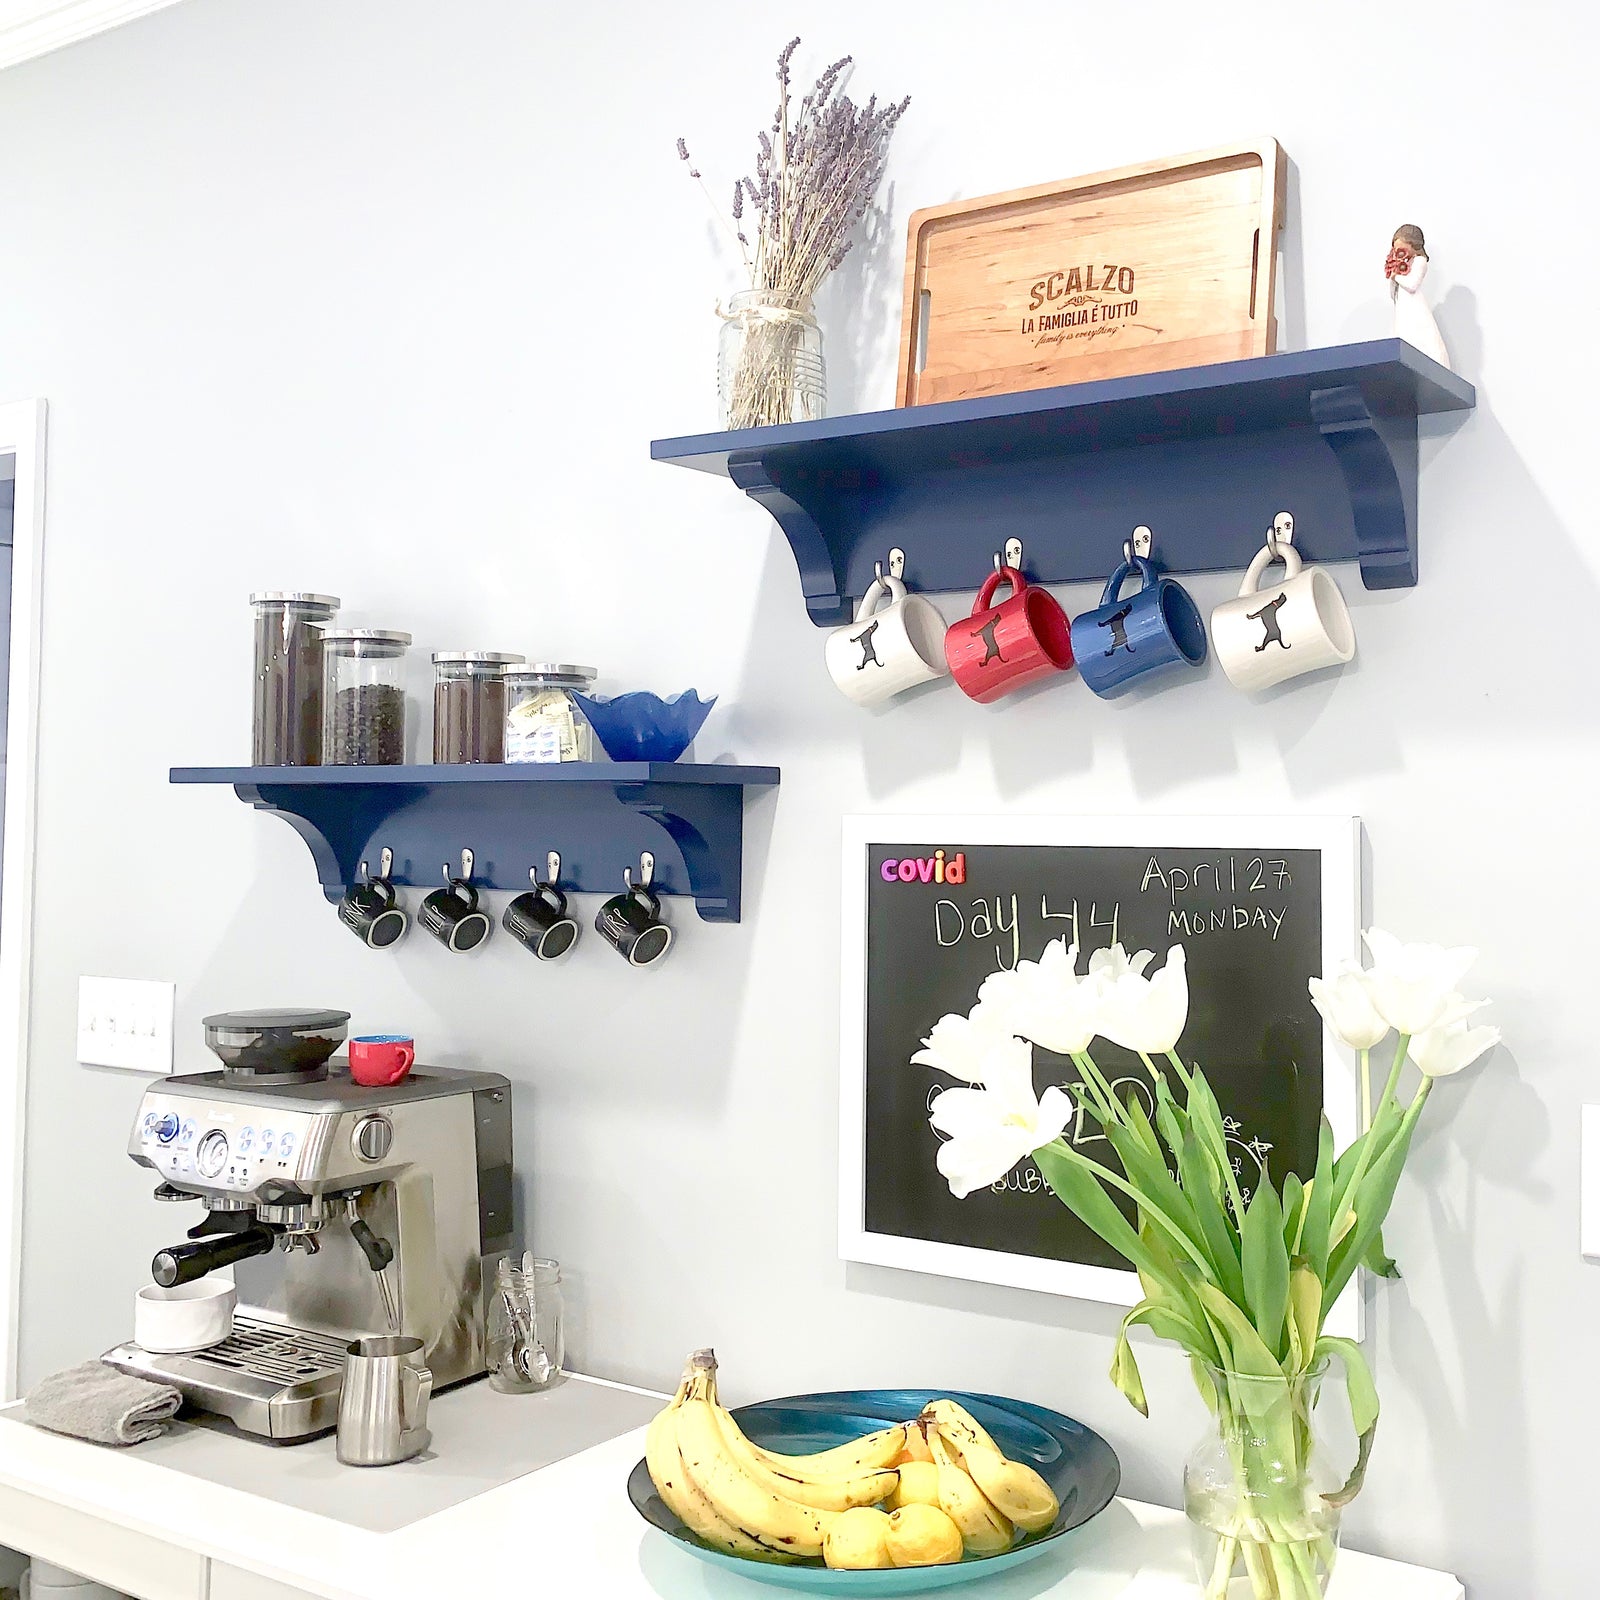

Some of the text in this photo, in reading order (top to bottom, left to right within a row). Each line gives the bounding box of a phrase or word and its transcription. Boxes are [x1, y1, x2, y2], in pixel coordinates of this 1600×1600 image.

[1029, 265, 1135, 311] SCALZO
[1021, 318, 1034, 335] LA
[1038, 309, 1088, 332] FAMIGLIA
[1101, 299, 1138, 321] TUTTO
[1034, 330, 1065, 348] family
[1074, 323, 1120, 341] everything
[880, 849, 967, 884] covid
[1140, 855, 1290, 906] April 27
[424, 904, 446, 935] ULP
[509, 914, 529, 940] SIP
[602, 907, 629, 947] LURP
[935, 892, 1119, 971] Day 44
[1167, 904, 1288, 941] MONDAY
